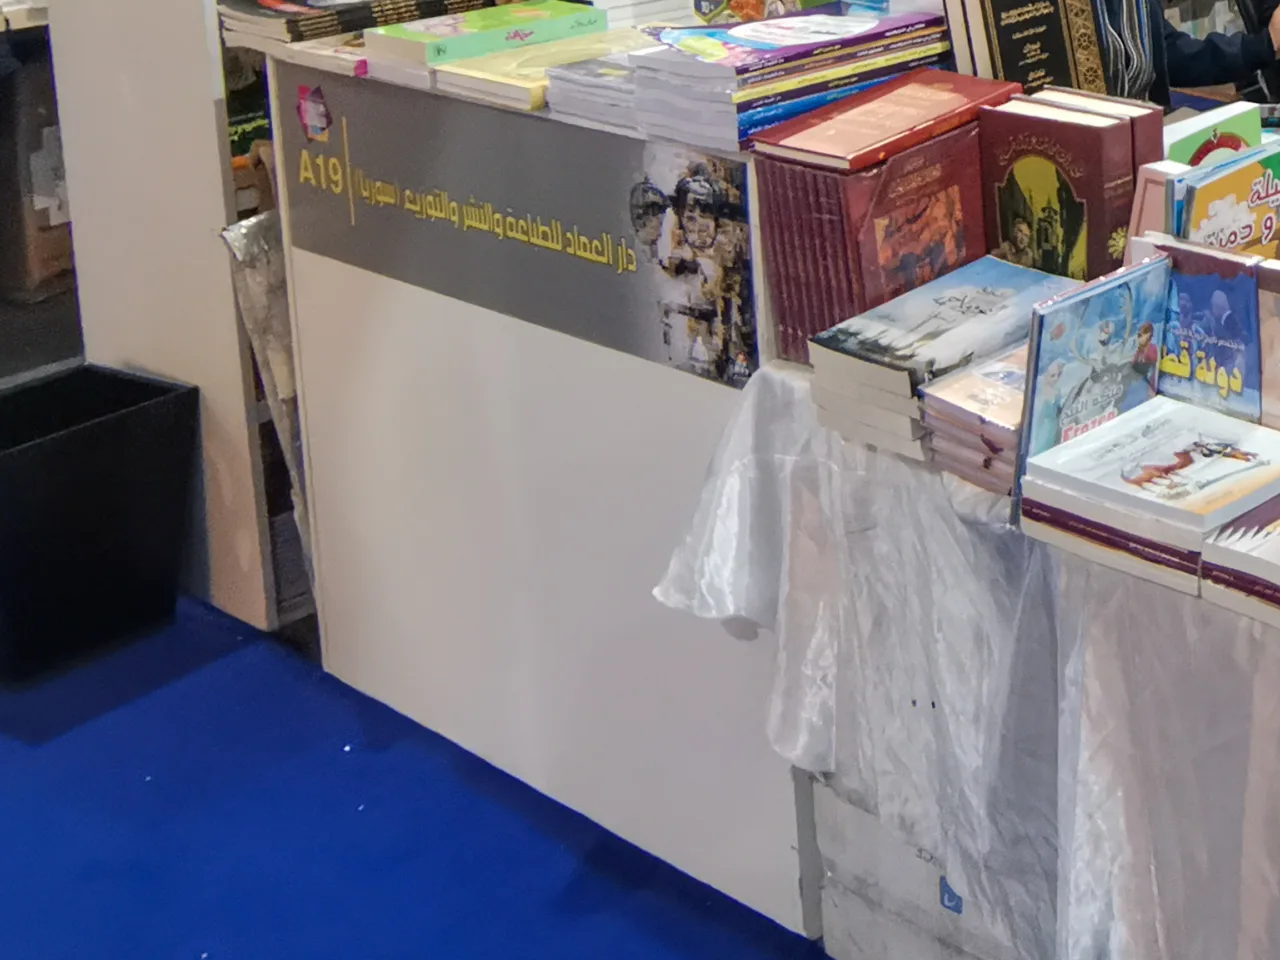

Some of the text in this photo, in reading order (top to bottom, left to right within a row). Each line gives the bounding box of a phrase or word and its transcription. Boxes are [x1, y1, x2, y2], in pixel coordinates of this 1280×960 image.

[299, 148, 343, 194] A19
[354, 168, 637, 274] دار العماد للطباعة والنشر والتوزيع (سوريا)
[1160, 339, 1192, 378] قط
[1194, 351, 1243, 398] دولة
